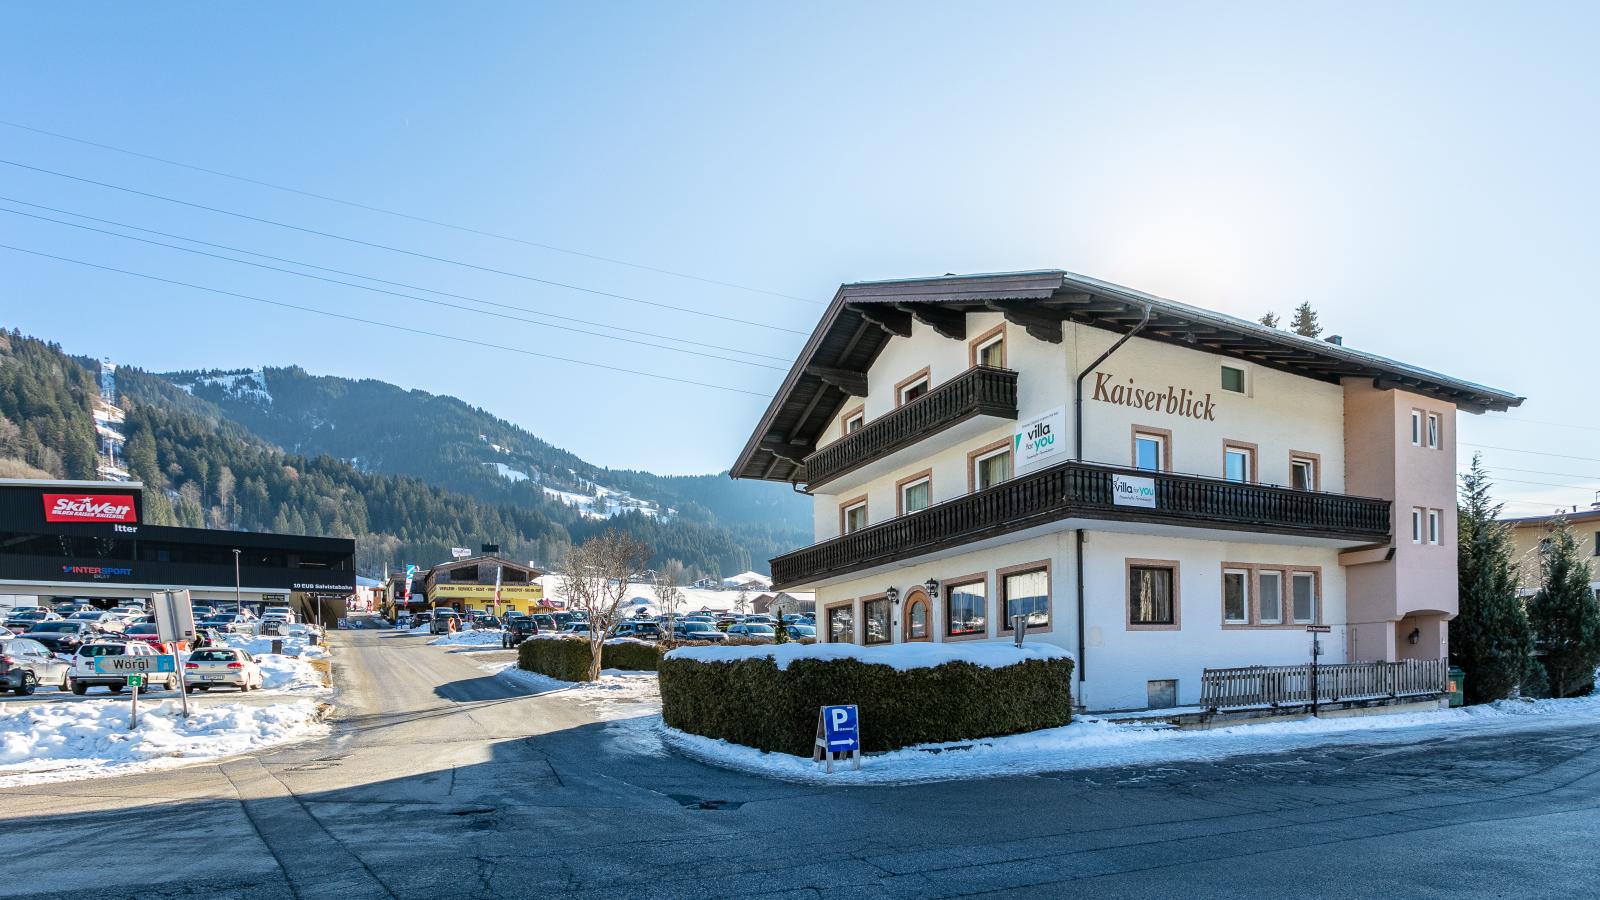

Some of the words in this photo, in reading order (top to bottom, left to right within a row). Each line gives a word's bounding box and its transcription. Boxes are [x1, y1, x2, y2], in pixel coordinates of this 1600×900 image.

[1092, 372, 1216, 421] Kaiserblick
[1027, 422, 1051, 440] villa
[1034, 433, 1055, 452] you
[1115, 481, 1133, 494] villa
[1140, 487, 1154, 496] you
[53, 498, 130, 515] SkiWelt
[114, 523, 138, 533] Itter
[72, 566, 132, 576] INTERSPORT
[113, 659, 149, 671] Wörgl
[831, 708, 848, 732] P
